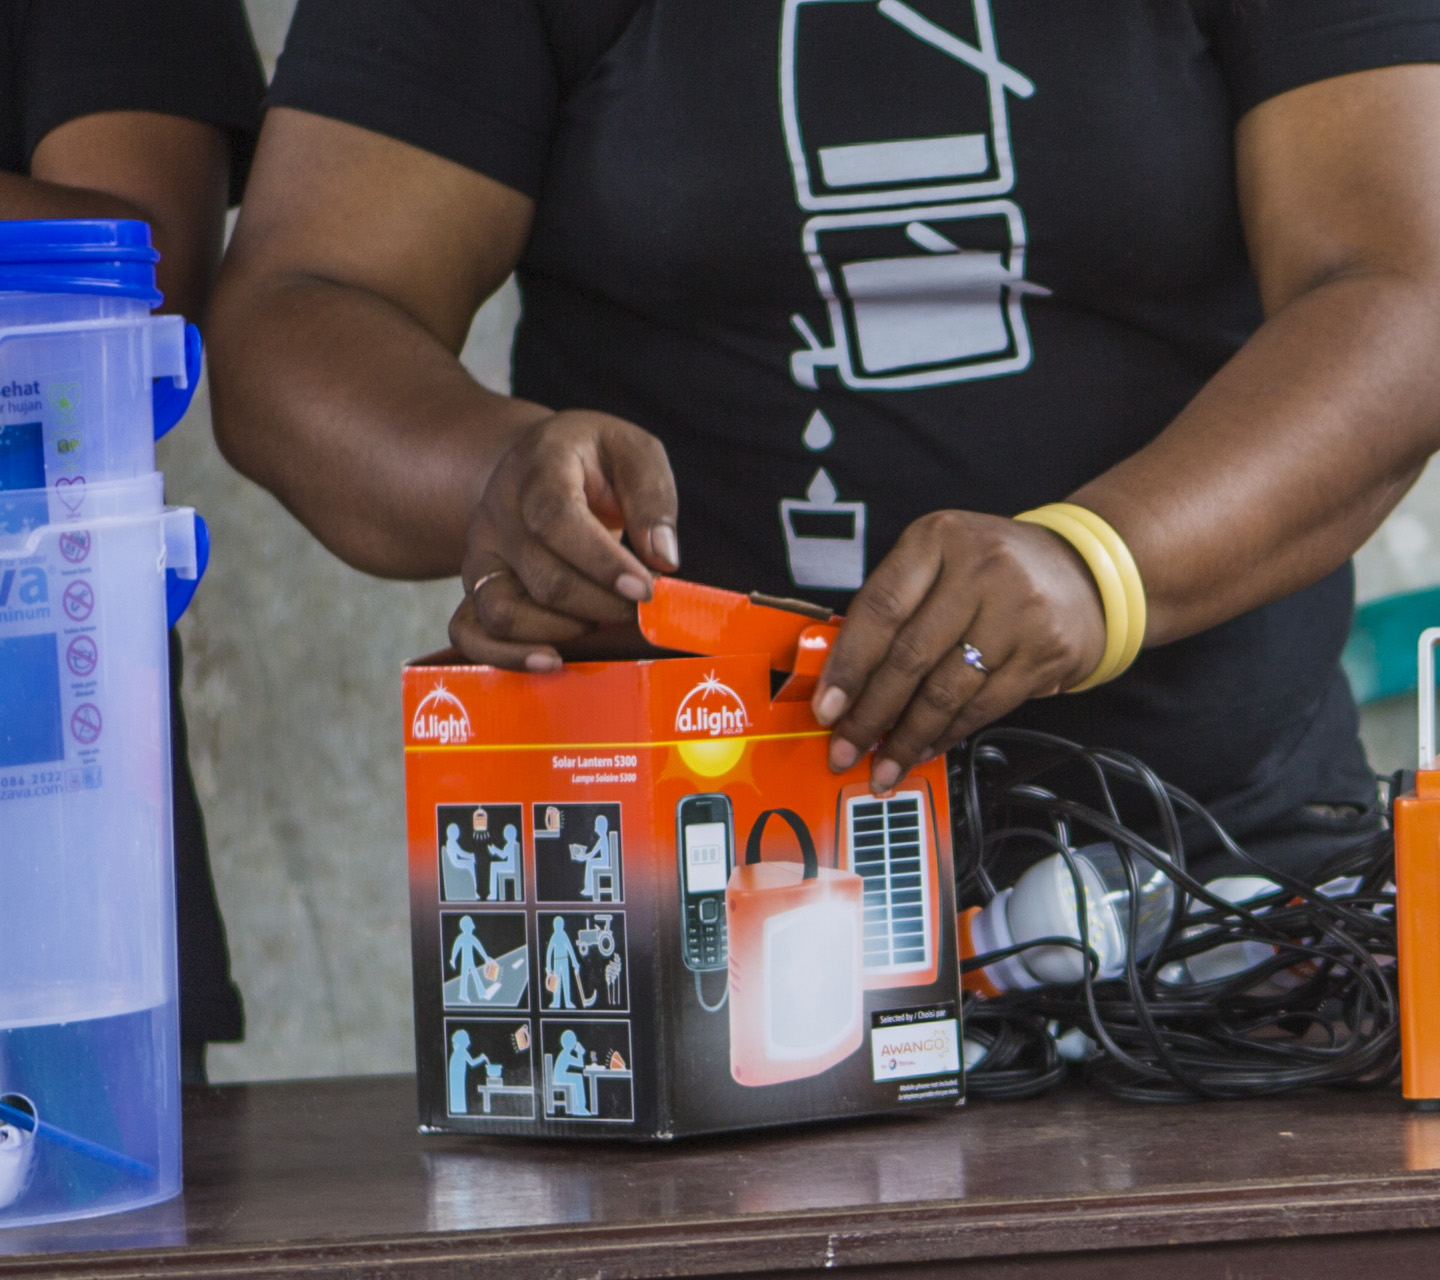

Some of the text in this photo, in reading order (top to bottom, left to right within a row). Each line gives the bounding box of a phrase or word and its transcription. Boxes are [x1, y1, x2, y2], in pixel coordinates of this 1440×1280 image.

[8, 401, 42, 415] hujan
[678, 705, 744, 736] d.light
[414, 714, 467, 744] d.light
[552, 755, 637, 768] Solar Lantern S300
[572, 774, 594, 784] Lampe
[881, 1038, 944, 1057] AWANGO
